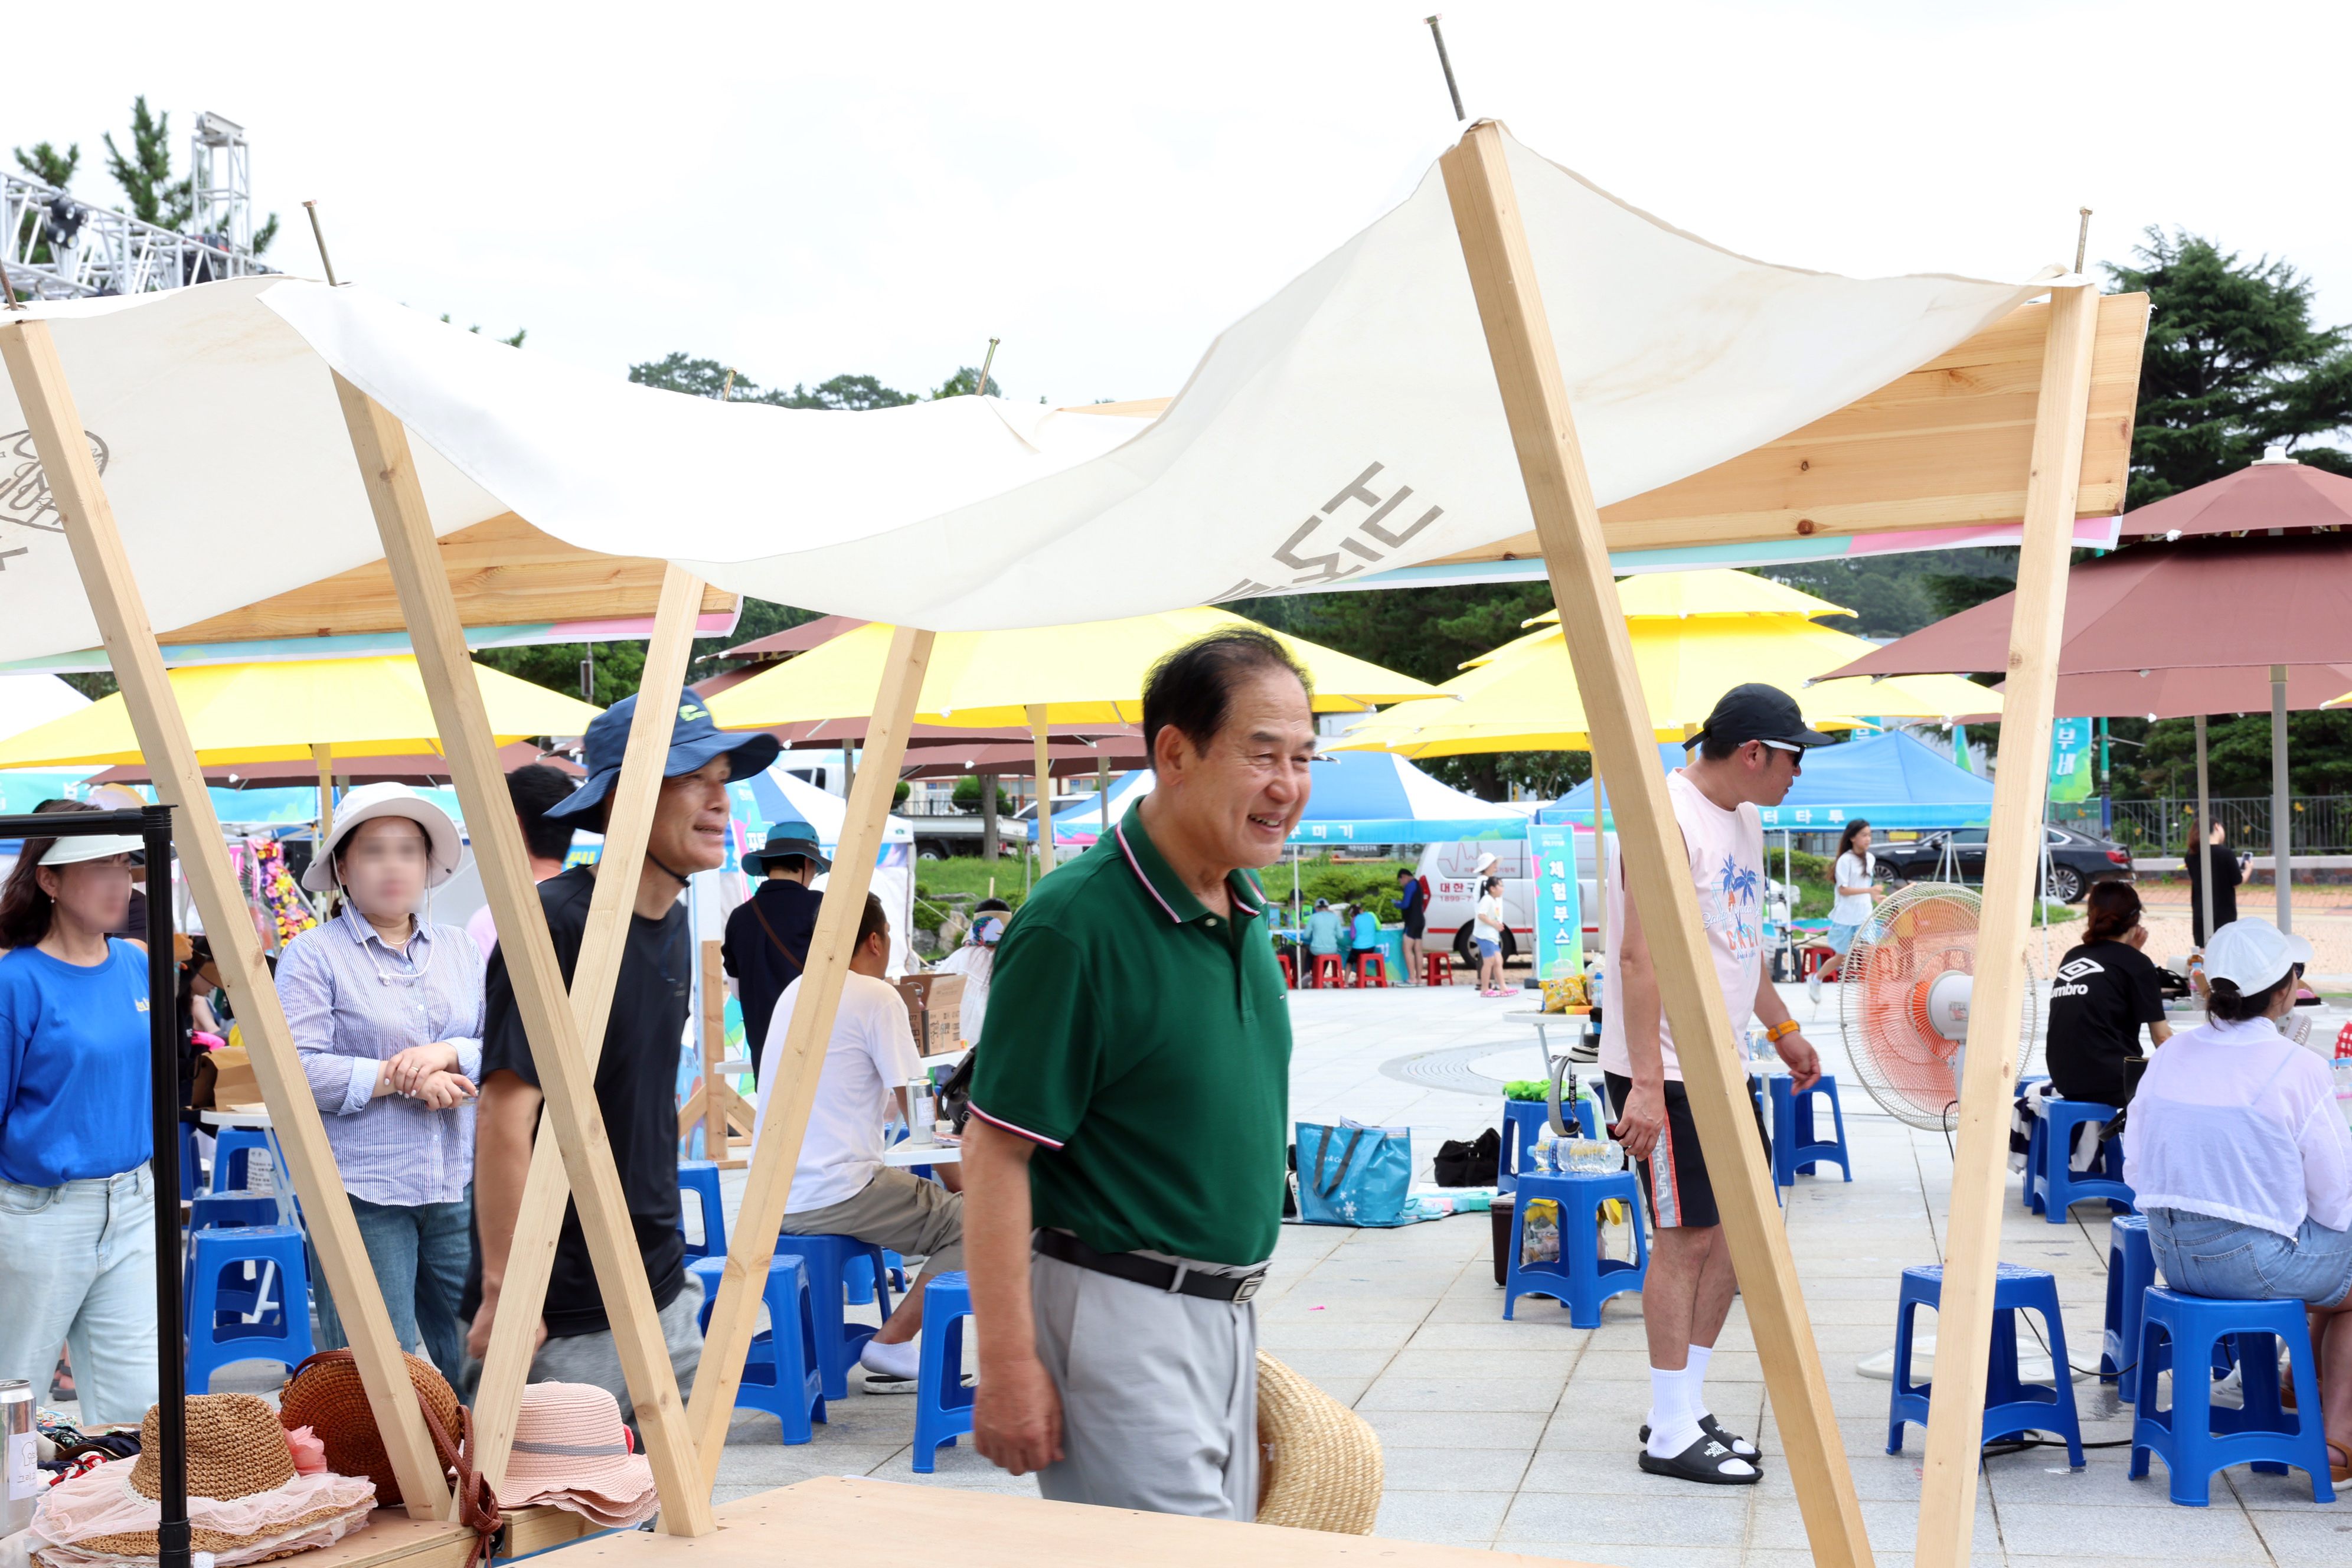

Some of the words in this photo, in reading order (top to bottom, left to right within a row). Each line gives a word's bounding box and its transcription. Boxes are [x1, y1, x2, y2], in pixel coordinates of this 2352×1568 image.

[1549, 860, 1570, 945] 체험부스
[1701, 911, 1727, 930] Santa
[1726, 925, 1759, 951] CALI
[2050, 982, 2089, 998] umbro
[1704, 1445, 1724, 1456] NORTH
